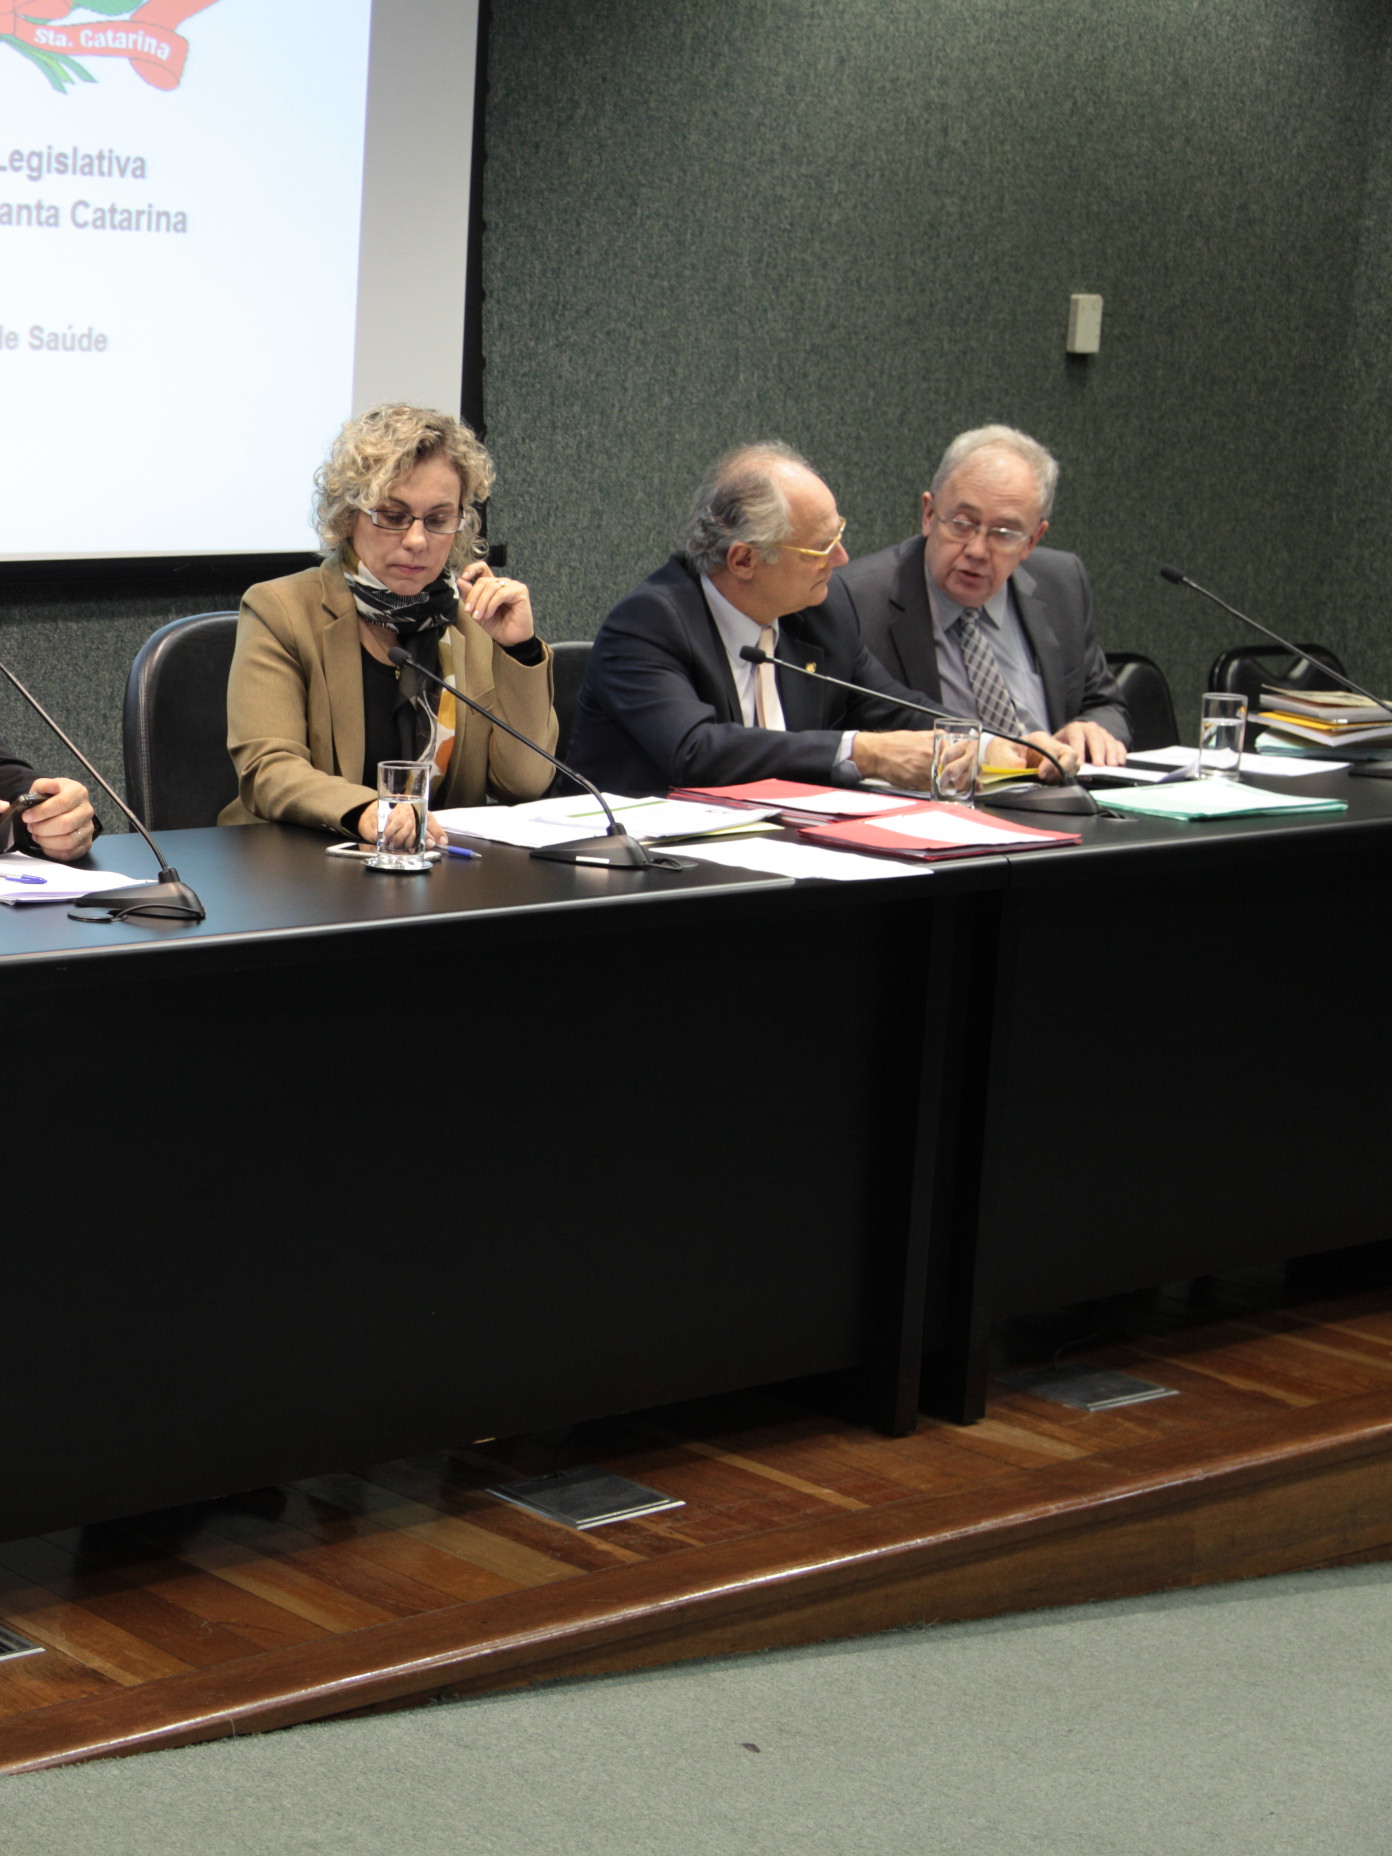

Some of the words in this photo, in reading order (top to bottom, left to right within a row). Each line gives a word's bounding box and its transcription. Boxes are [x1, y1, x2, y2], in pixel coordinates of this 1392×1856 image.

[33, 27, 74, 48] Sta.
[79, 28, 171, 61] Catarina
[71, 199, 189, 234] Catarina
[27, 324, 110, 353] Saúde
